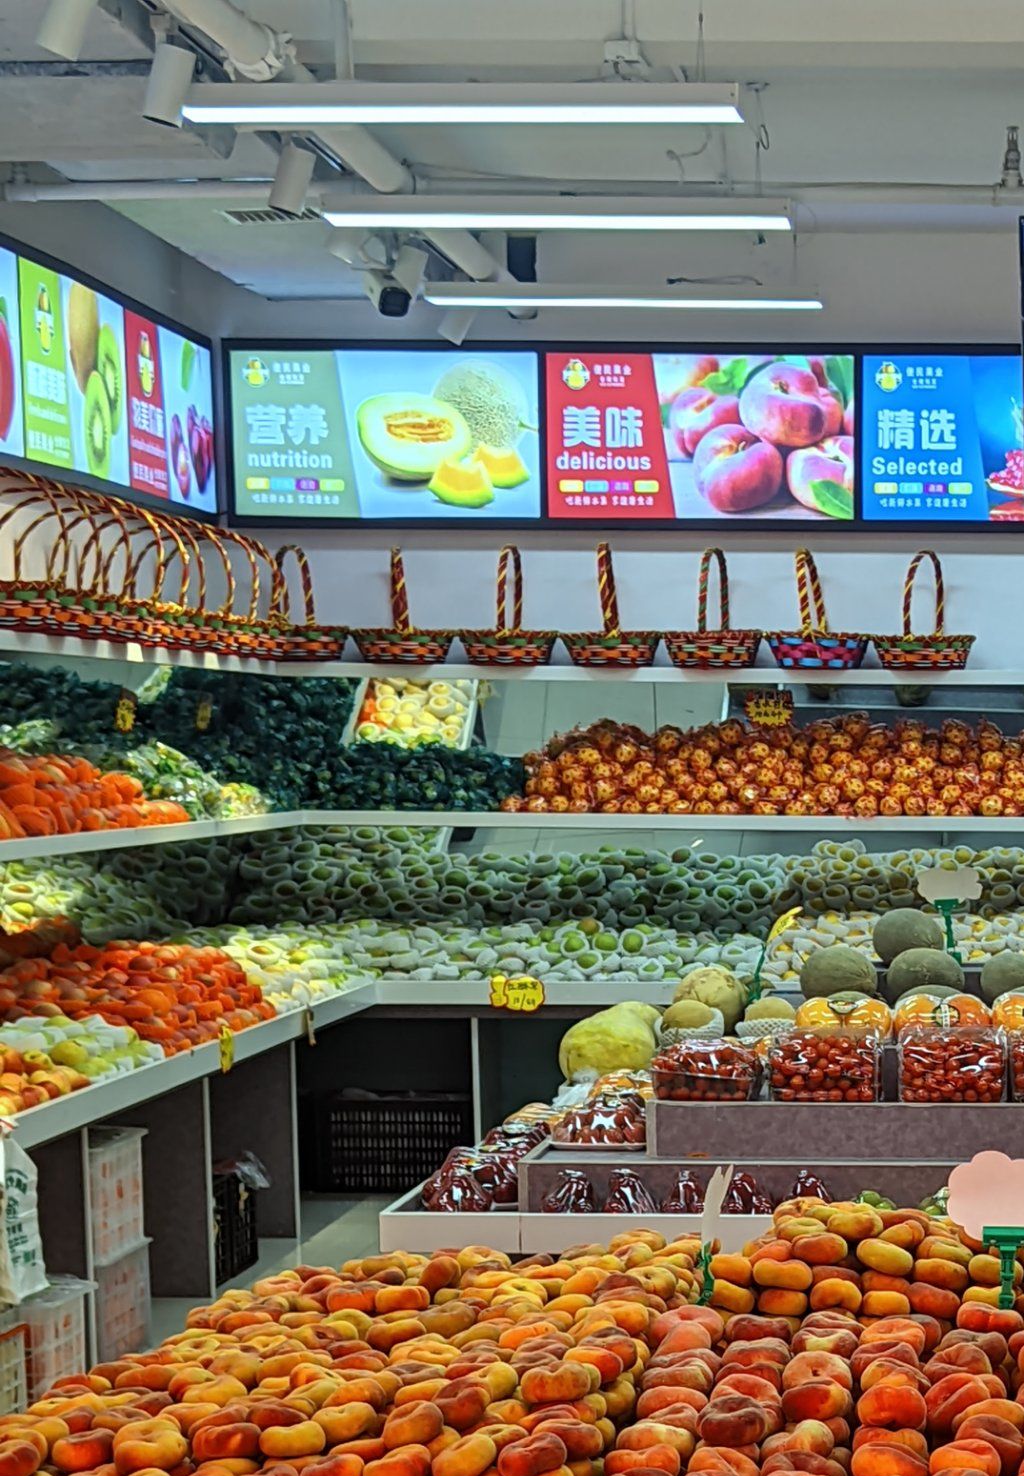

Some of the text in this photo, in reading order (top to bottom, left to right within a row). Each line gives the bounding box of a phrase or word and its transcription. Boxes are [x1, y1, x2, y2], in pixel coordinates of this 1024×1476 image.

[245, 404, 329, 446] 营养
[562, 406, 643, 448] 美味
[877, 408, 957, 451] 精选
[247, 450, 333, 468] nutrition
[556, 451, 651, 470] delicious
[872, 456, 963, 476] Selected
